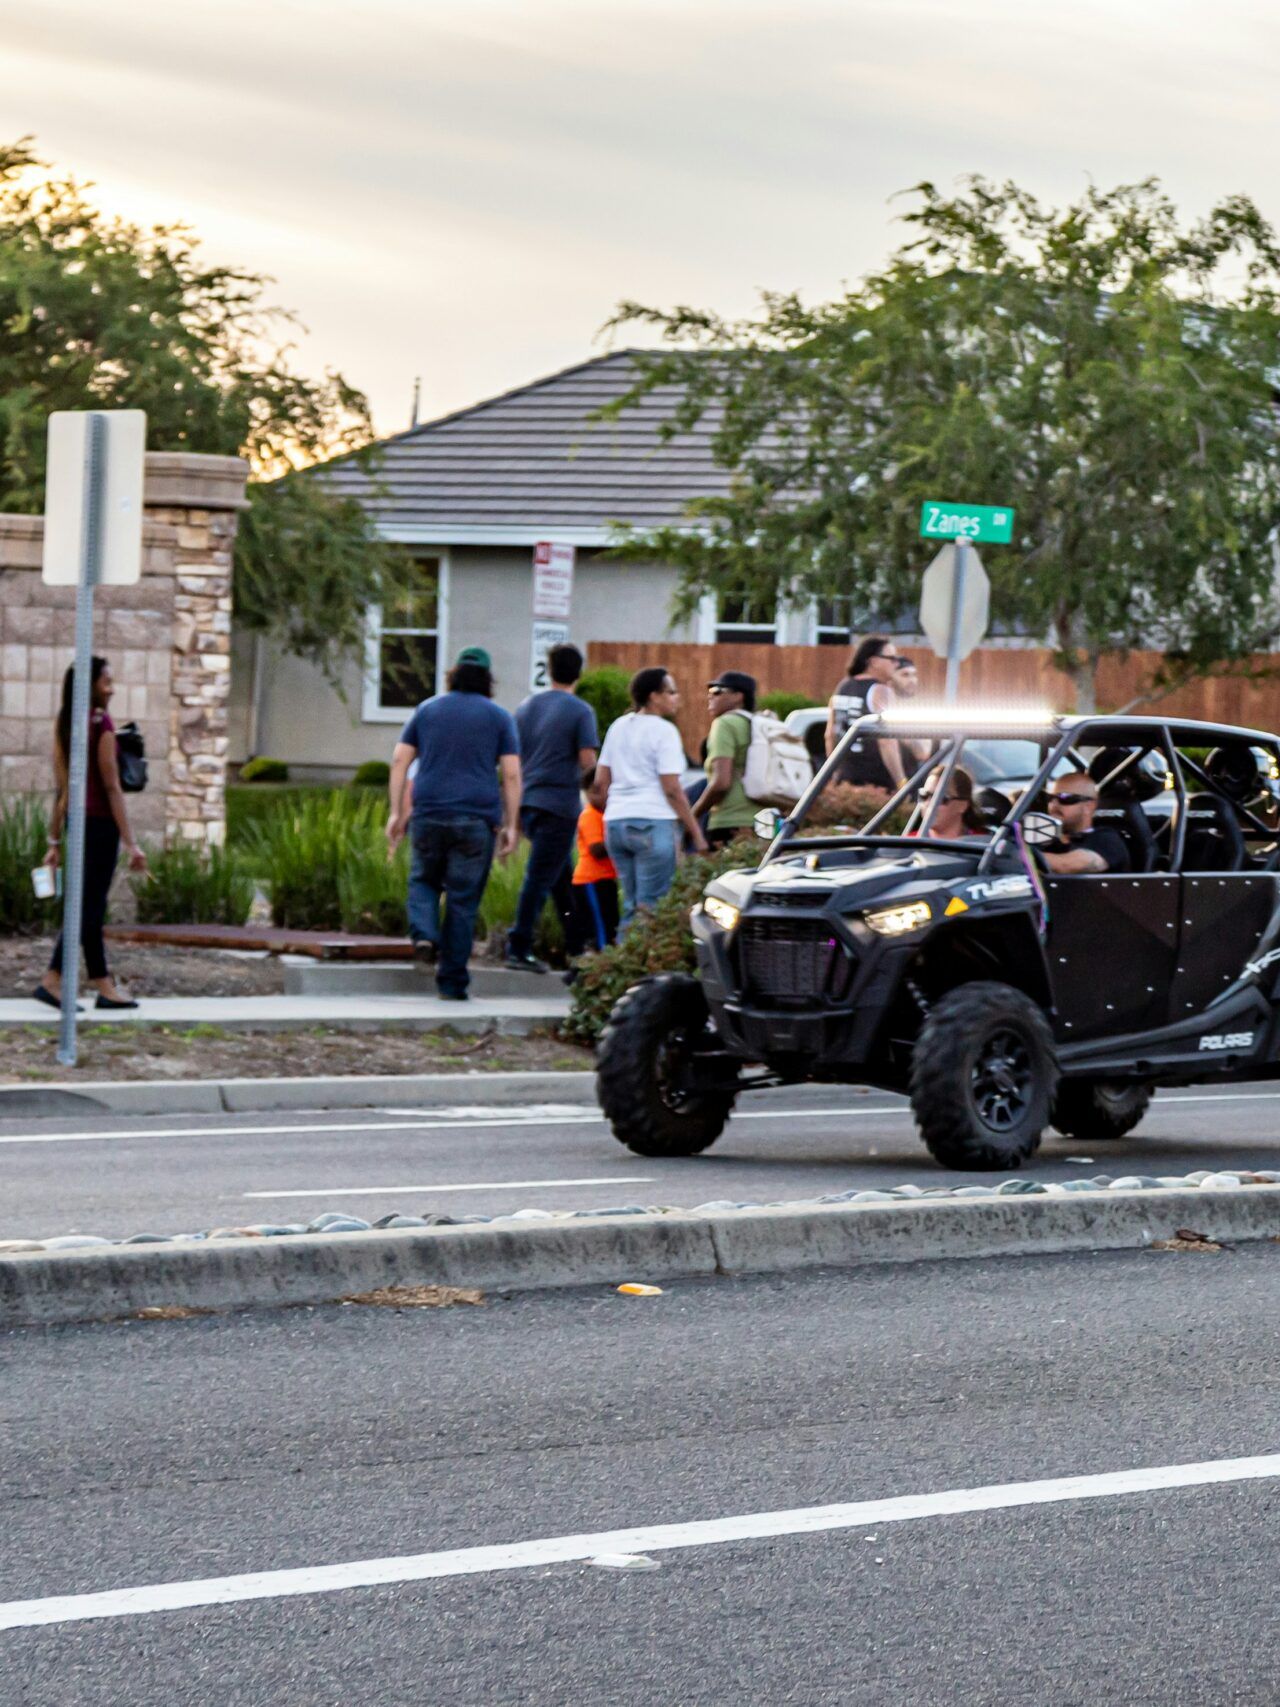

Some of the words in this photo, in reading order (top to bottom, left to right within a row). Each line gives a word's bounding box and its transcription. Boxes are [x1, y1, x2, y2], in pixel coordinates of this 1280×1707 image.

[926, 507, 980, 536] Zanes
[534, 662, 547, 687] 2
[1199, 1032, 1254, 1051] POLARIS
